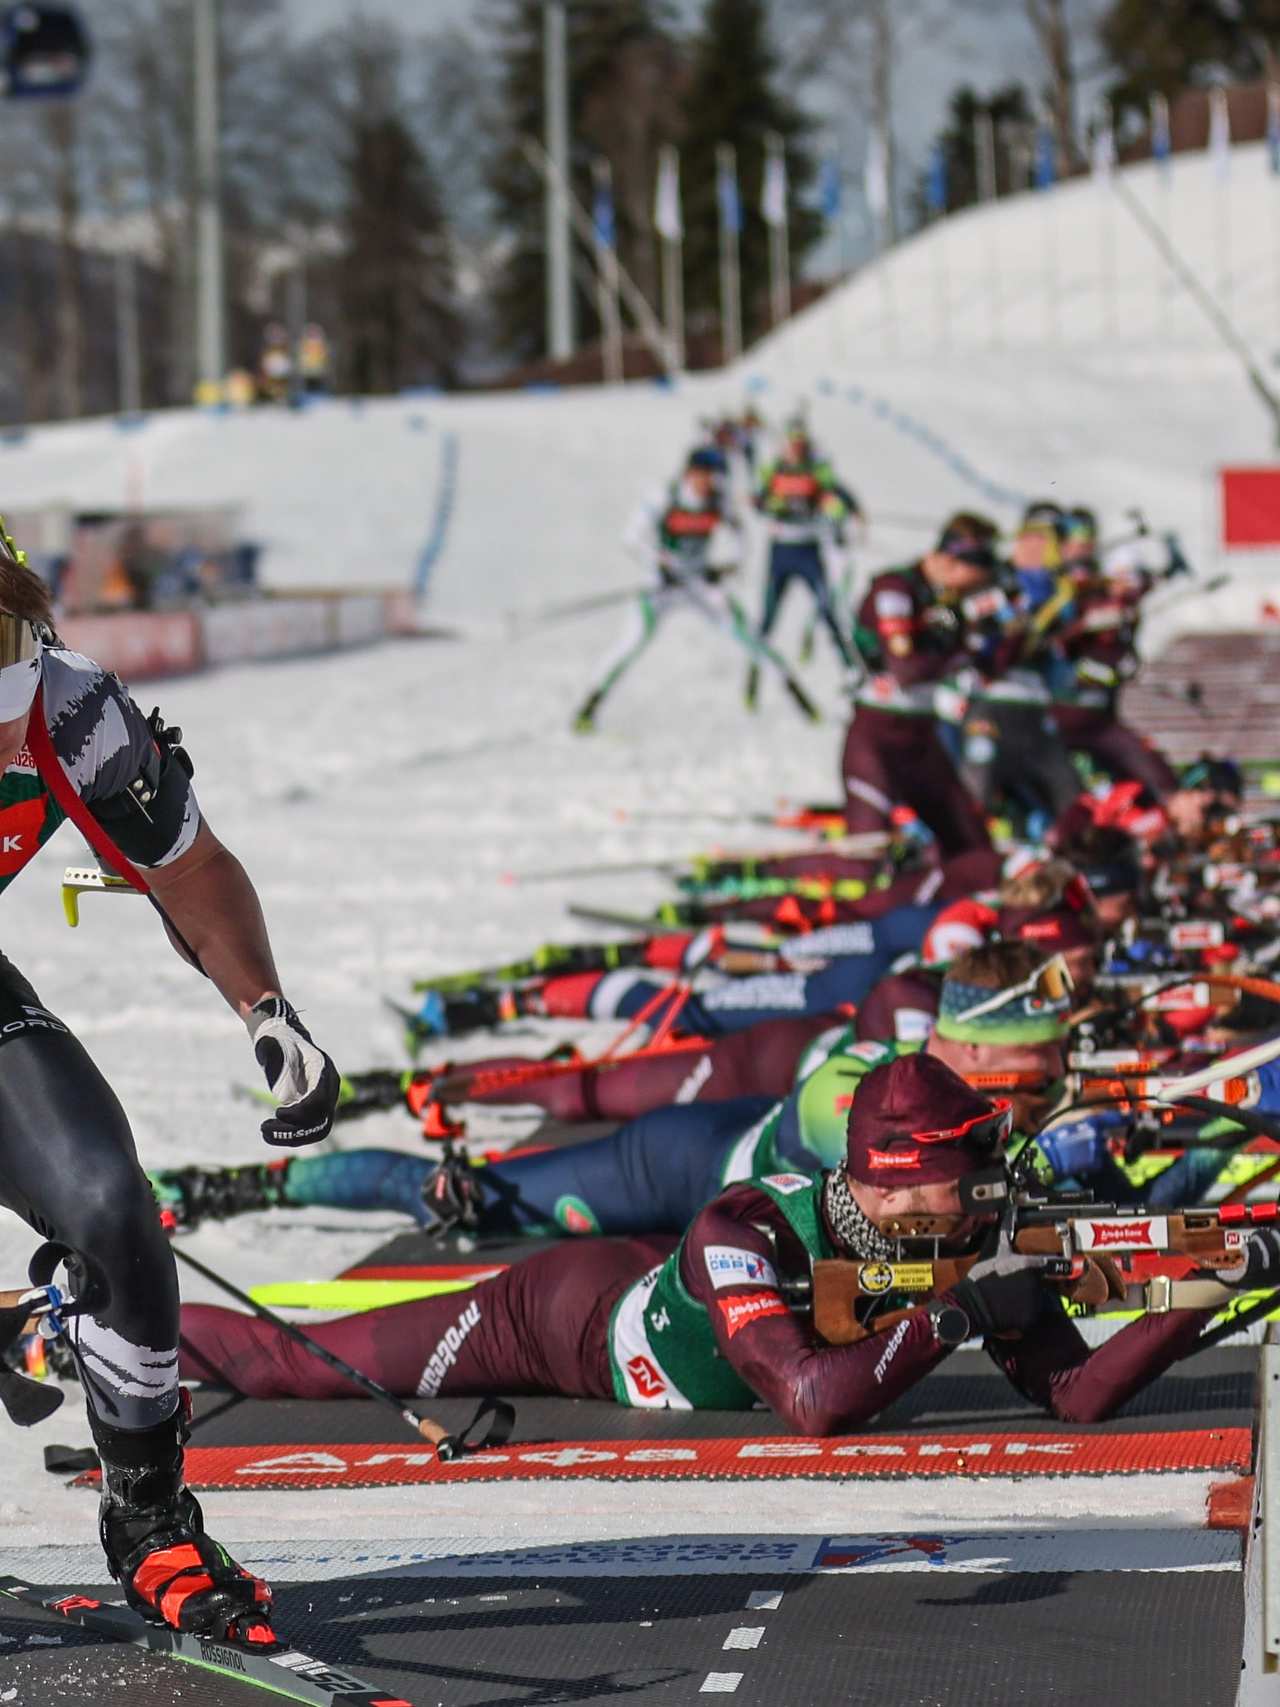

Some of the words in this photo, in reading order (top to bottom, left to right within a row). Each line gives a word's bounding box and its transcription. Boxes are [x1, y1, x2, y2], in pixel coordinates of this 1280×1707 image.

[1101, 1229, 1124, 1240] Альфа
[1125, 1229, 1142, 1237] Банк
[728, 1302, 760, 1324] Альфа
[760, 1298, 782, 1309] Бан
[736, 1443, 1083, 1458] Банк
